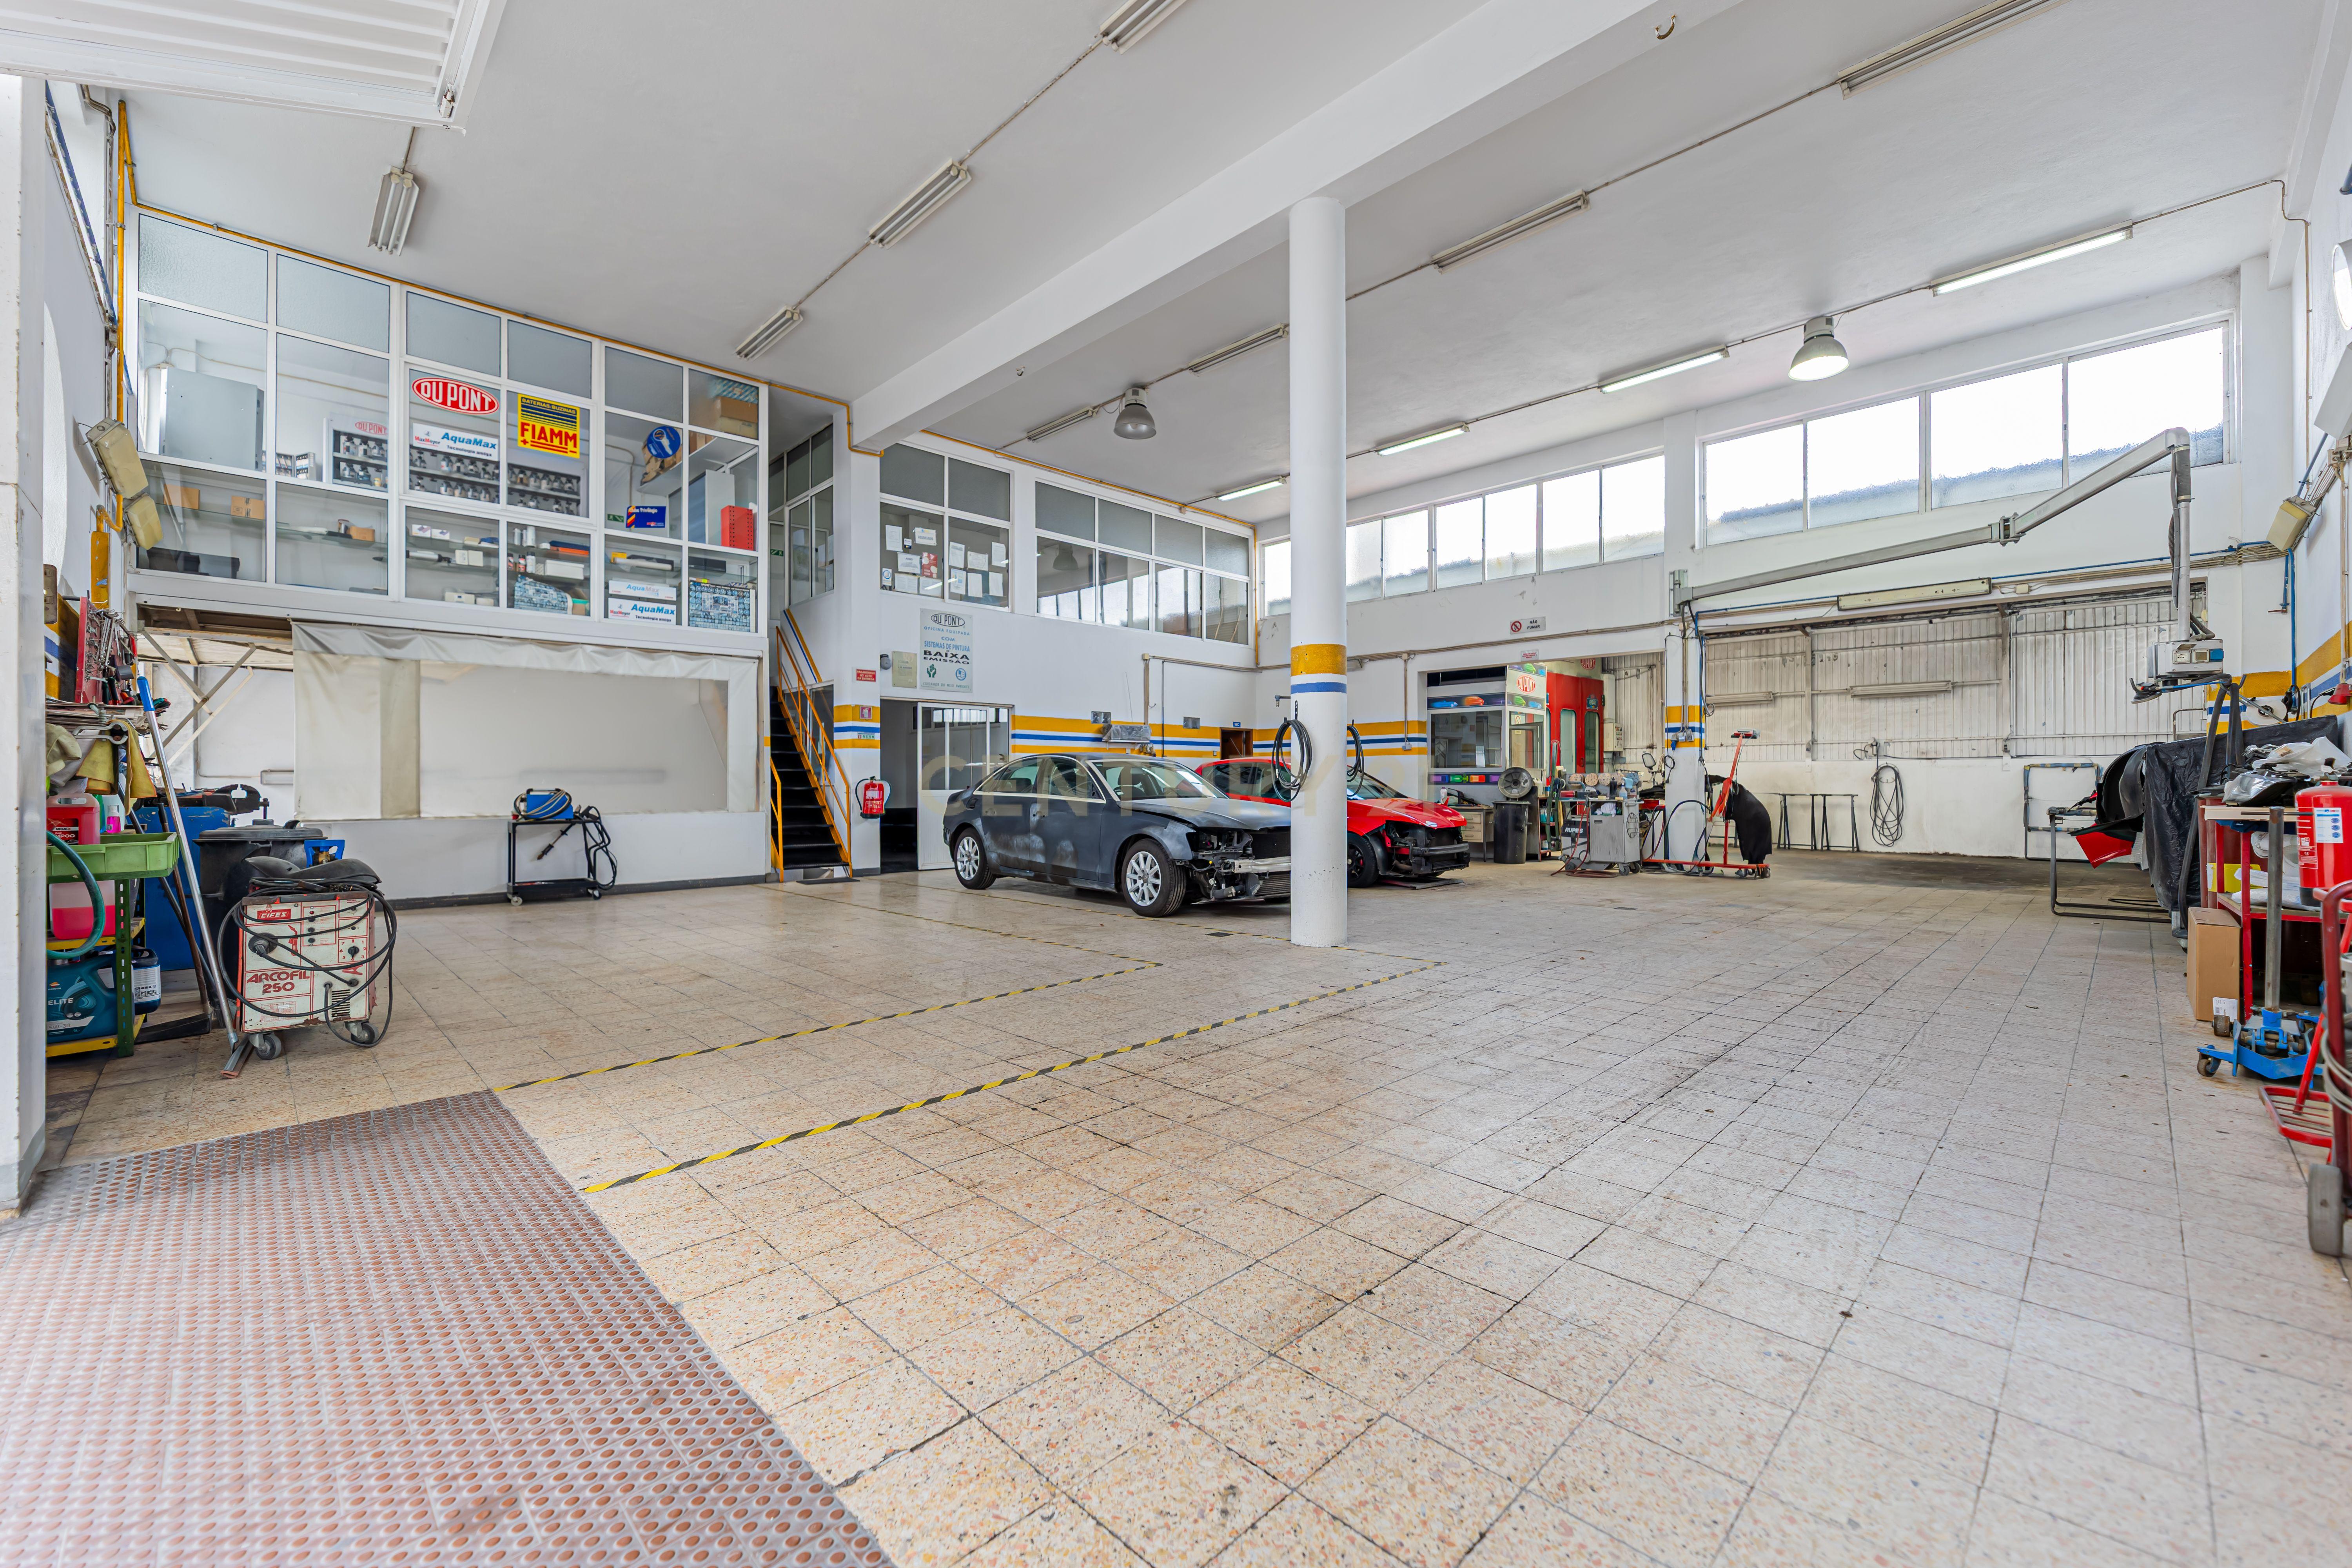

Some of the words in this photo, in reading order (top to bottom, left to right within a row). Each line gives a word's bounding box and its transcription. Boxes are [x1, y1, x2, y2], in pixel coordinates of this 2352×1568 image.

[420, 381, 443, 403] DU
[447, 383, 492, 411] PONT
[414, 436, 440, 445] MaxMeyer
[441, 432, 497, 449] AquaMax
[521, 422, 577, 448] FIAMM
[447, 445, 475, 454] Tecnologia
[626, 584, 659, 593] AquaMax
[631, 604, 675, 615] AquaMax
[933, 615, 942, 623] DU
[944, 615, 961, 626] PONT
[924, 650, 969, 660] BAIXA
[1518, 677, 1523, 690] DU
[1524, 677, 1535, 692] PONT
[247, 970, 310, 984] ARCOFIL
[262, 982, 295, 994] 250
